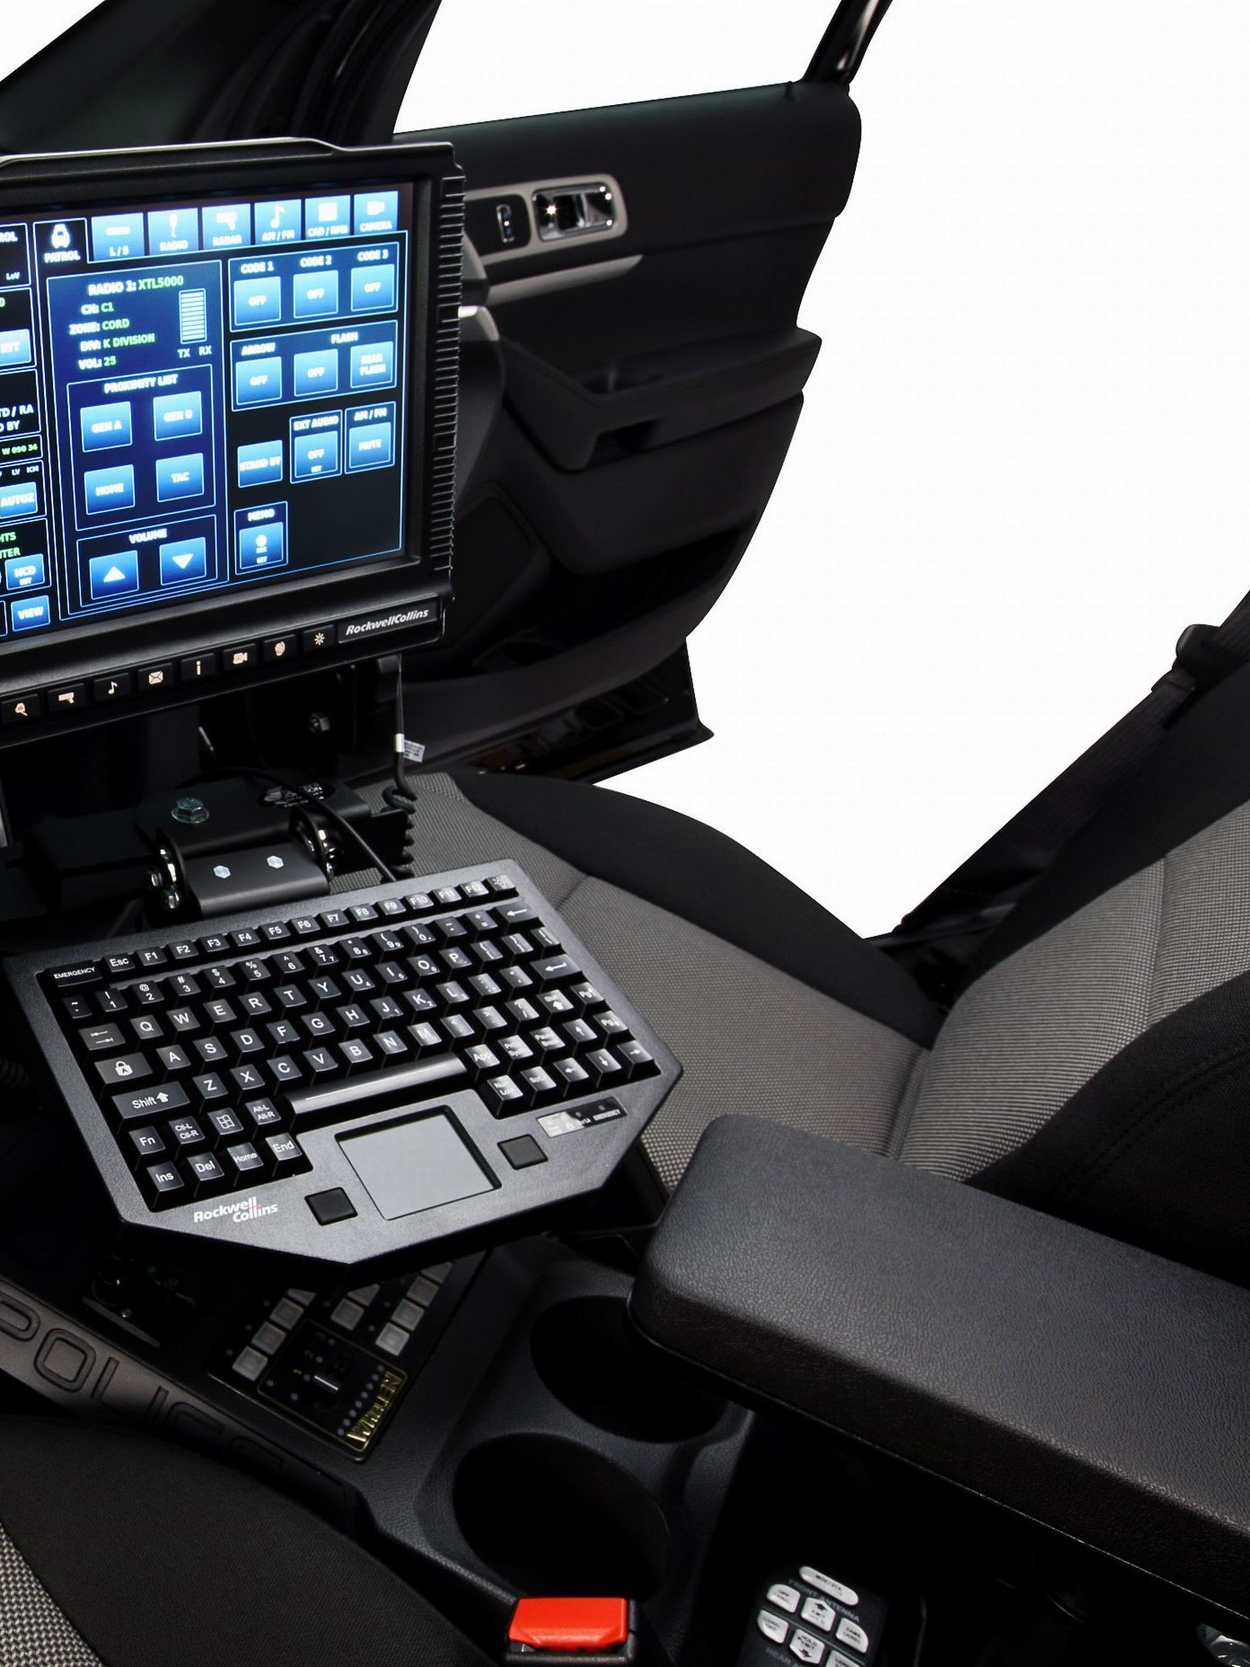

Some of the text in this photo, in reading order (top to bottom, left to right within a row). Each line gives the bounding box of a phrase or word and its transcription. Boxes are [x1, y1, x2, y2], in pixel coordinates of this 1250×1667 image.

[382, 250, 388, 258] 3
[326, 256, 332, 265] 2
[88, 276, 184, 296] RADIO XTL5000
[101, 302, 114, 313] C1
[102, 318, 130, 330] CORD
[103, 334, 155, 348] K DIVISION
[178, 346, 212, 358] TX RX
[78, 356, 116, 370] VOL: 25
[19, 404, 33, 415] RA
[6, 421, 20, 431] BY
[356, 908, 369, 916] F8
[327, 914, 339, 923] F7
[298, 920, 311, 929] F6
[268, 927, 282, 935] F5
[239, 933, 252, 942] F4
[207, 939, 221, 947] F3
[176, 945, 190, 954] F2
[145, 952, 158, 961] F1
[110, 958, 129, 967] Esc
[418, 960, 430, 969] O
[54, 967, 95, 979] EMERGENCY
[254, 969, 261, 978] 5
[350, 975, 363, 984] U
[318, 982, 329, 992] Y
[284, 990, 293, 1001] T
[413, 994, 426, 1004] K
[248, 998, 262, 1008] R
[213, 1006, 226, 1016] E
[345, 1010, 359, 1020] H
[174, 1013, 190, 1024] W
[311, 1019, 324, 1028] G
[140, 1021, 154, 1031] Q
[276, 1026, 287, 1036] F
[240, 1034, 253, 1045] D
[383, 1037, 397, 1048] N
[204, 1043, 216, 1053] S
[350, 1045, 362, 1055] B
[169, 1052, 181, 1062] A
[312, 1054, 324, 1064] V
[278, 1062, 290, 1073] C
[240, 1071, 255, 1082] X
[204, 1080, 217, 1091] Z
[132, 1097, 157, 1109] Shift
[139, 1137, 155, 1146] Fn
[273, 1141, 294, 1153] End
[234, 1152, 257, 1162] Home
[196, 1161, 215, 1174] Del
[156, 1172, 174, 1183] Ins
[193, 1197, 258, 1223] Rockwell
[232, 1203, 278, 1223] Collins
